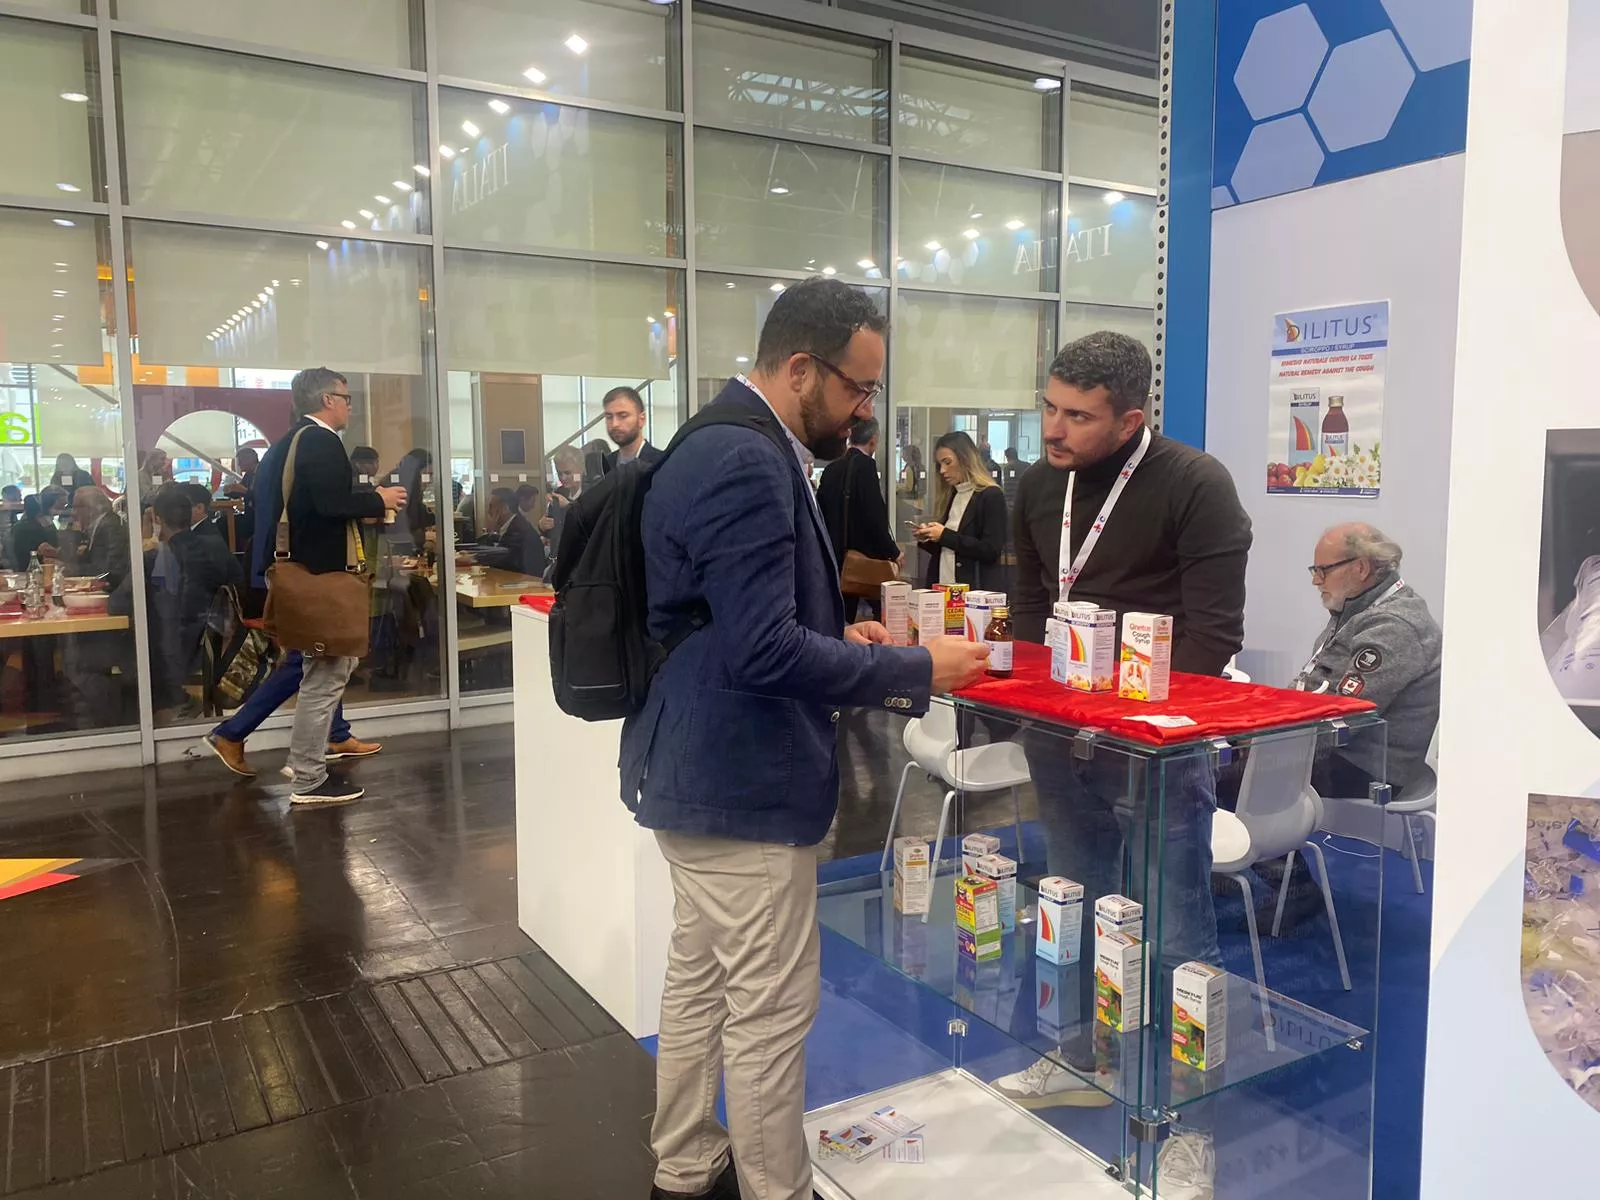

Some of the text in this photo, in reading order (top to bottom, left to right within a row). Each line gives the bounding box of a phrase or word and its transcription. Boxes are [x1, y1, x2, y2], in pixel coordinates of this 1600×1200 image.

[1284, 315, 1372, 343] DILITUS
[1132, 631, 1151, 639] Cough
[1135, 637, 1151, 645] Syrup
